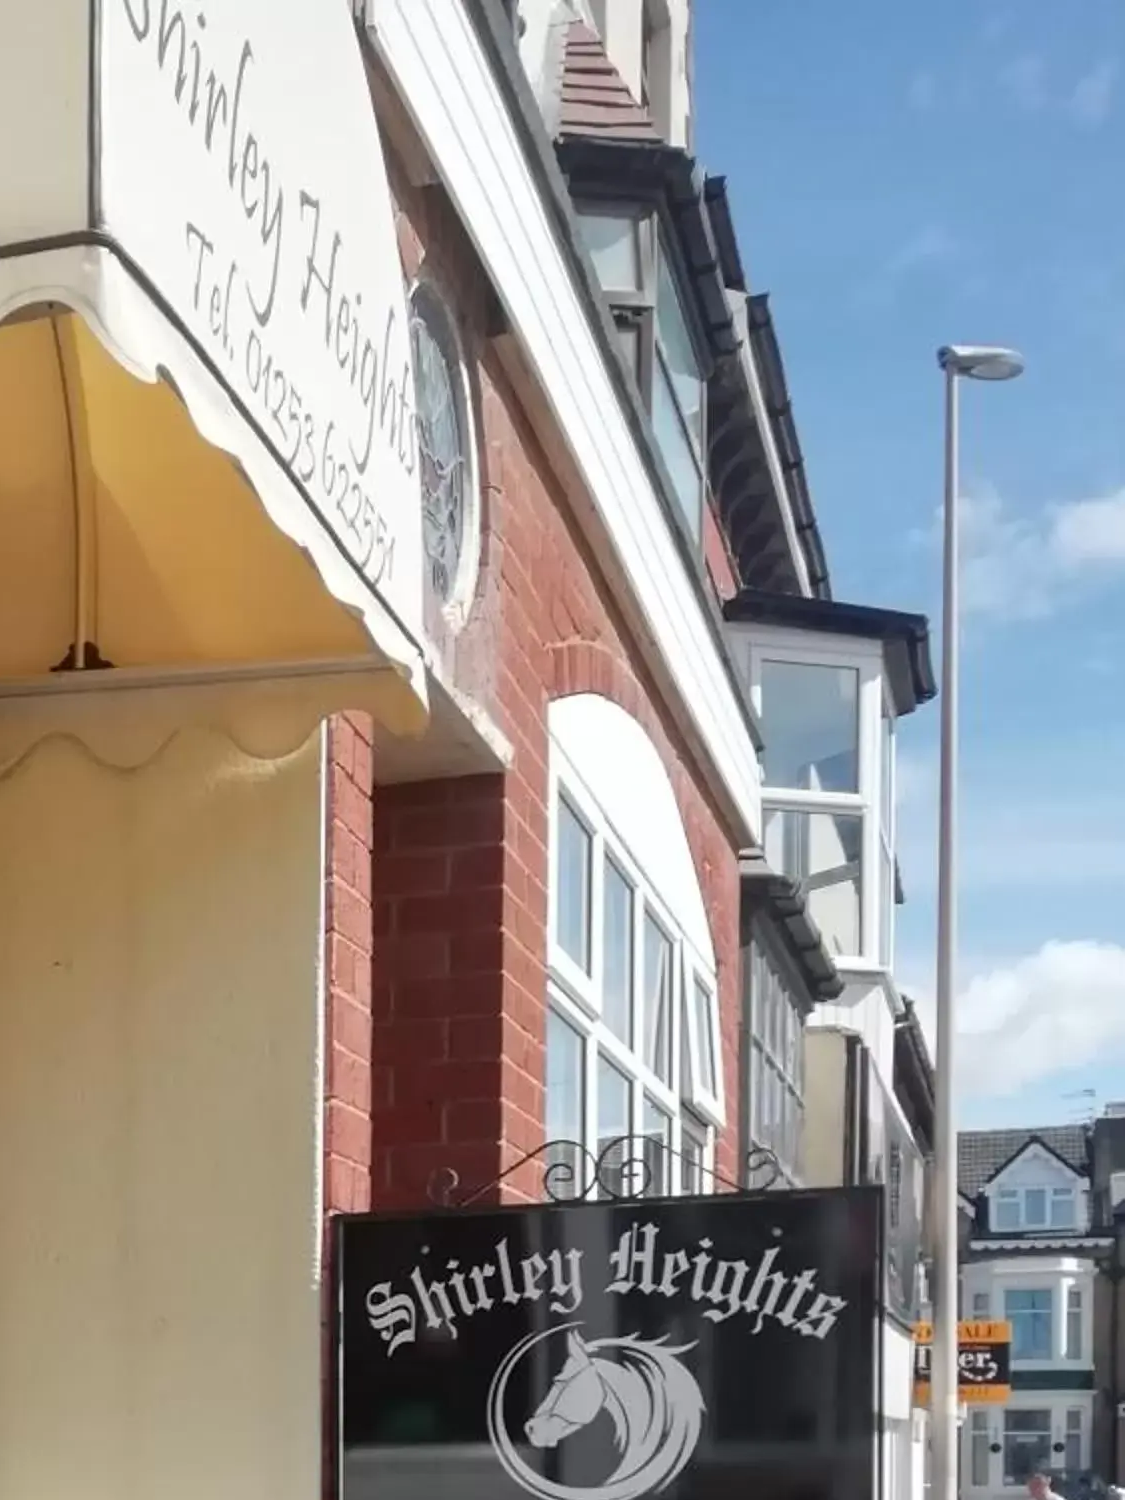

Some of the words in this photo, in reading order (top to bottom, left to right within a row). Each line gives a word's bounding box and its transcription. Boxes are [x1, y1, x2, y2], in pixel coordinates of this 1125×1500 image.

[246, 329, 316, 482] 01253
[322, 421, 395, 586] 622551
[300, 190, 416, 476] Heights
[365, 1237, 584, 1358] Shirley
[603, 1220, 849, 1341] Heights
